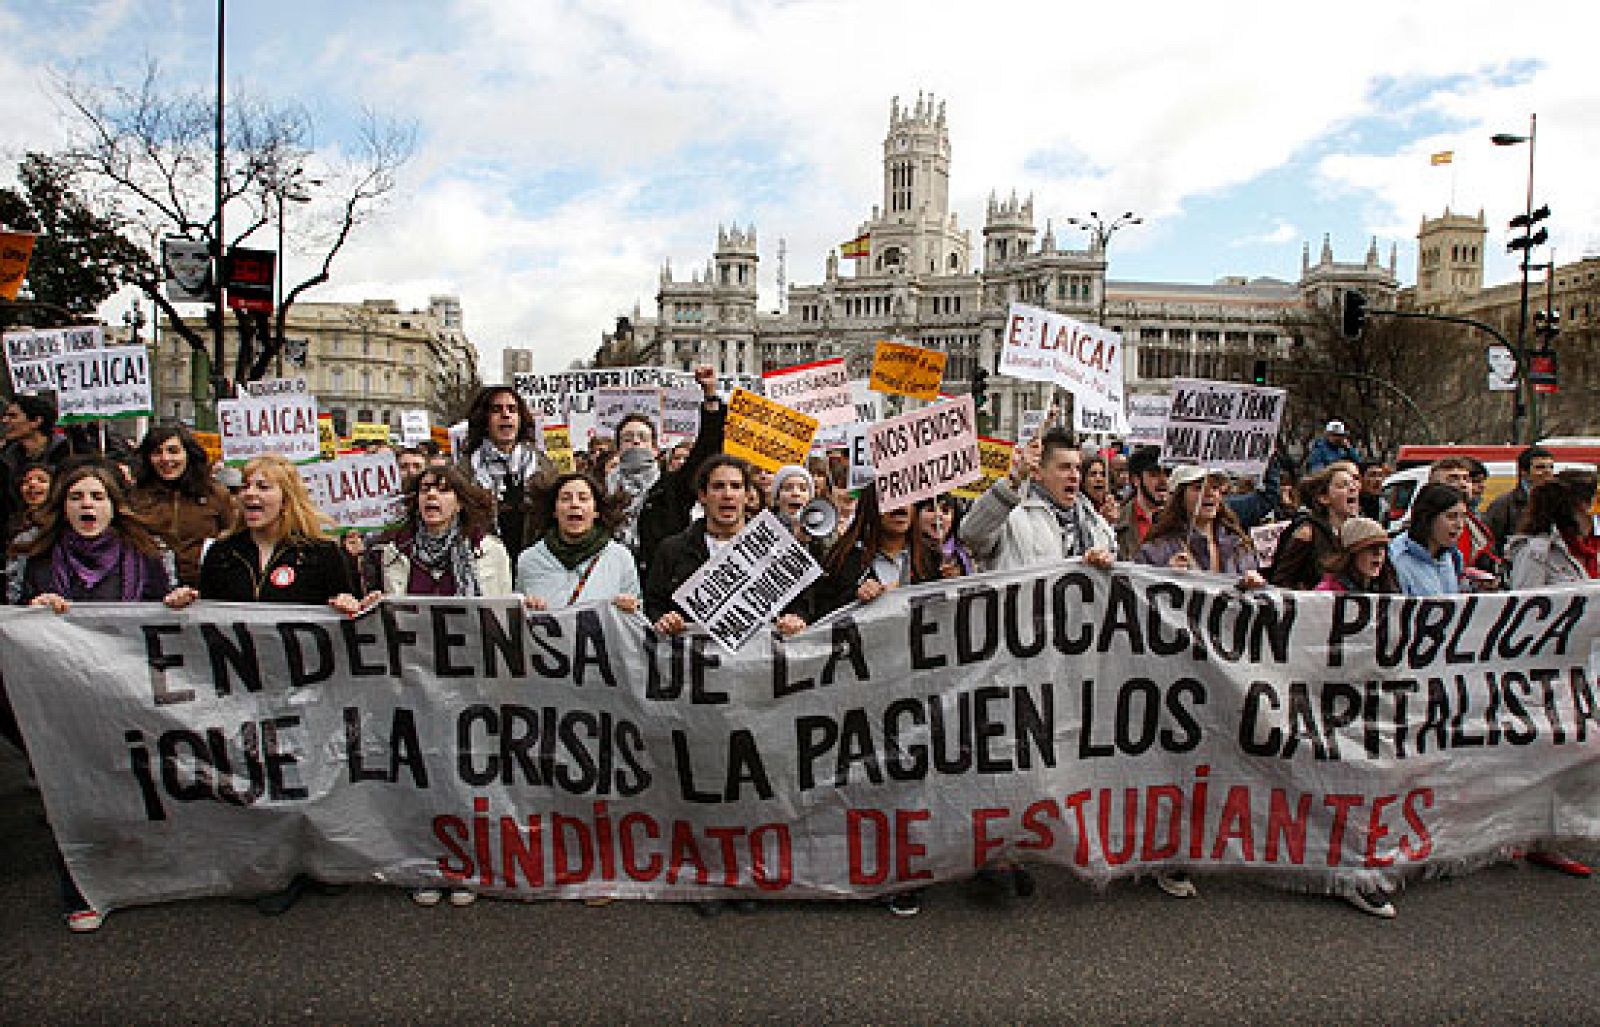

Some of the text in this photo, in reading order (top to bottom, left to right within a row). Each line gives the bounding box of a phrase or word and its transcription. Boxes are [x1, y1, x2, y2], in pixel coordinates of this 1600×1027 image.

[141, 622, 264, 707] EN
[275, 604, 618, 688] DEFENSA
[643, 626, 731, 705] DE
[770, 617, 871, 700] LA
[125, 714, 309, 821] ¡QUE
[343, 706, 429, 788] LA
[457, 703, 652, 797] CRISIS
[671, 728, 774, 804] LA
[796, 684, 1056, 791] PAGUEN
[1079, 676, 1208, 760] LOS
[432, 765, 1435, 891] SINDICATO DE ESTUDIANTES
